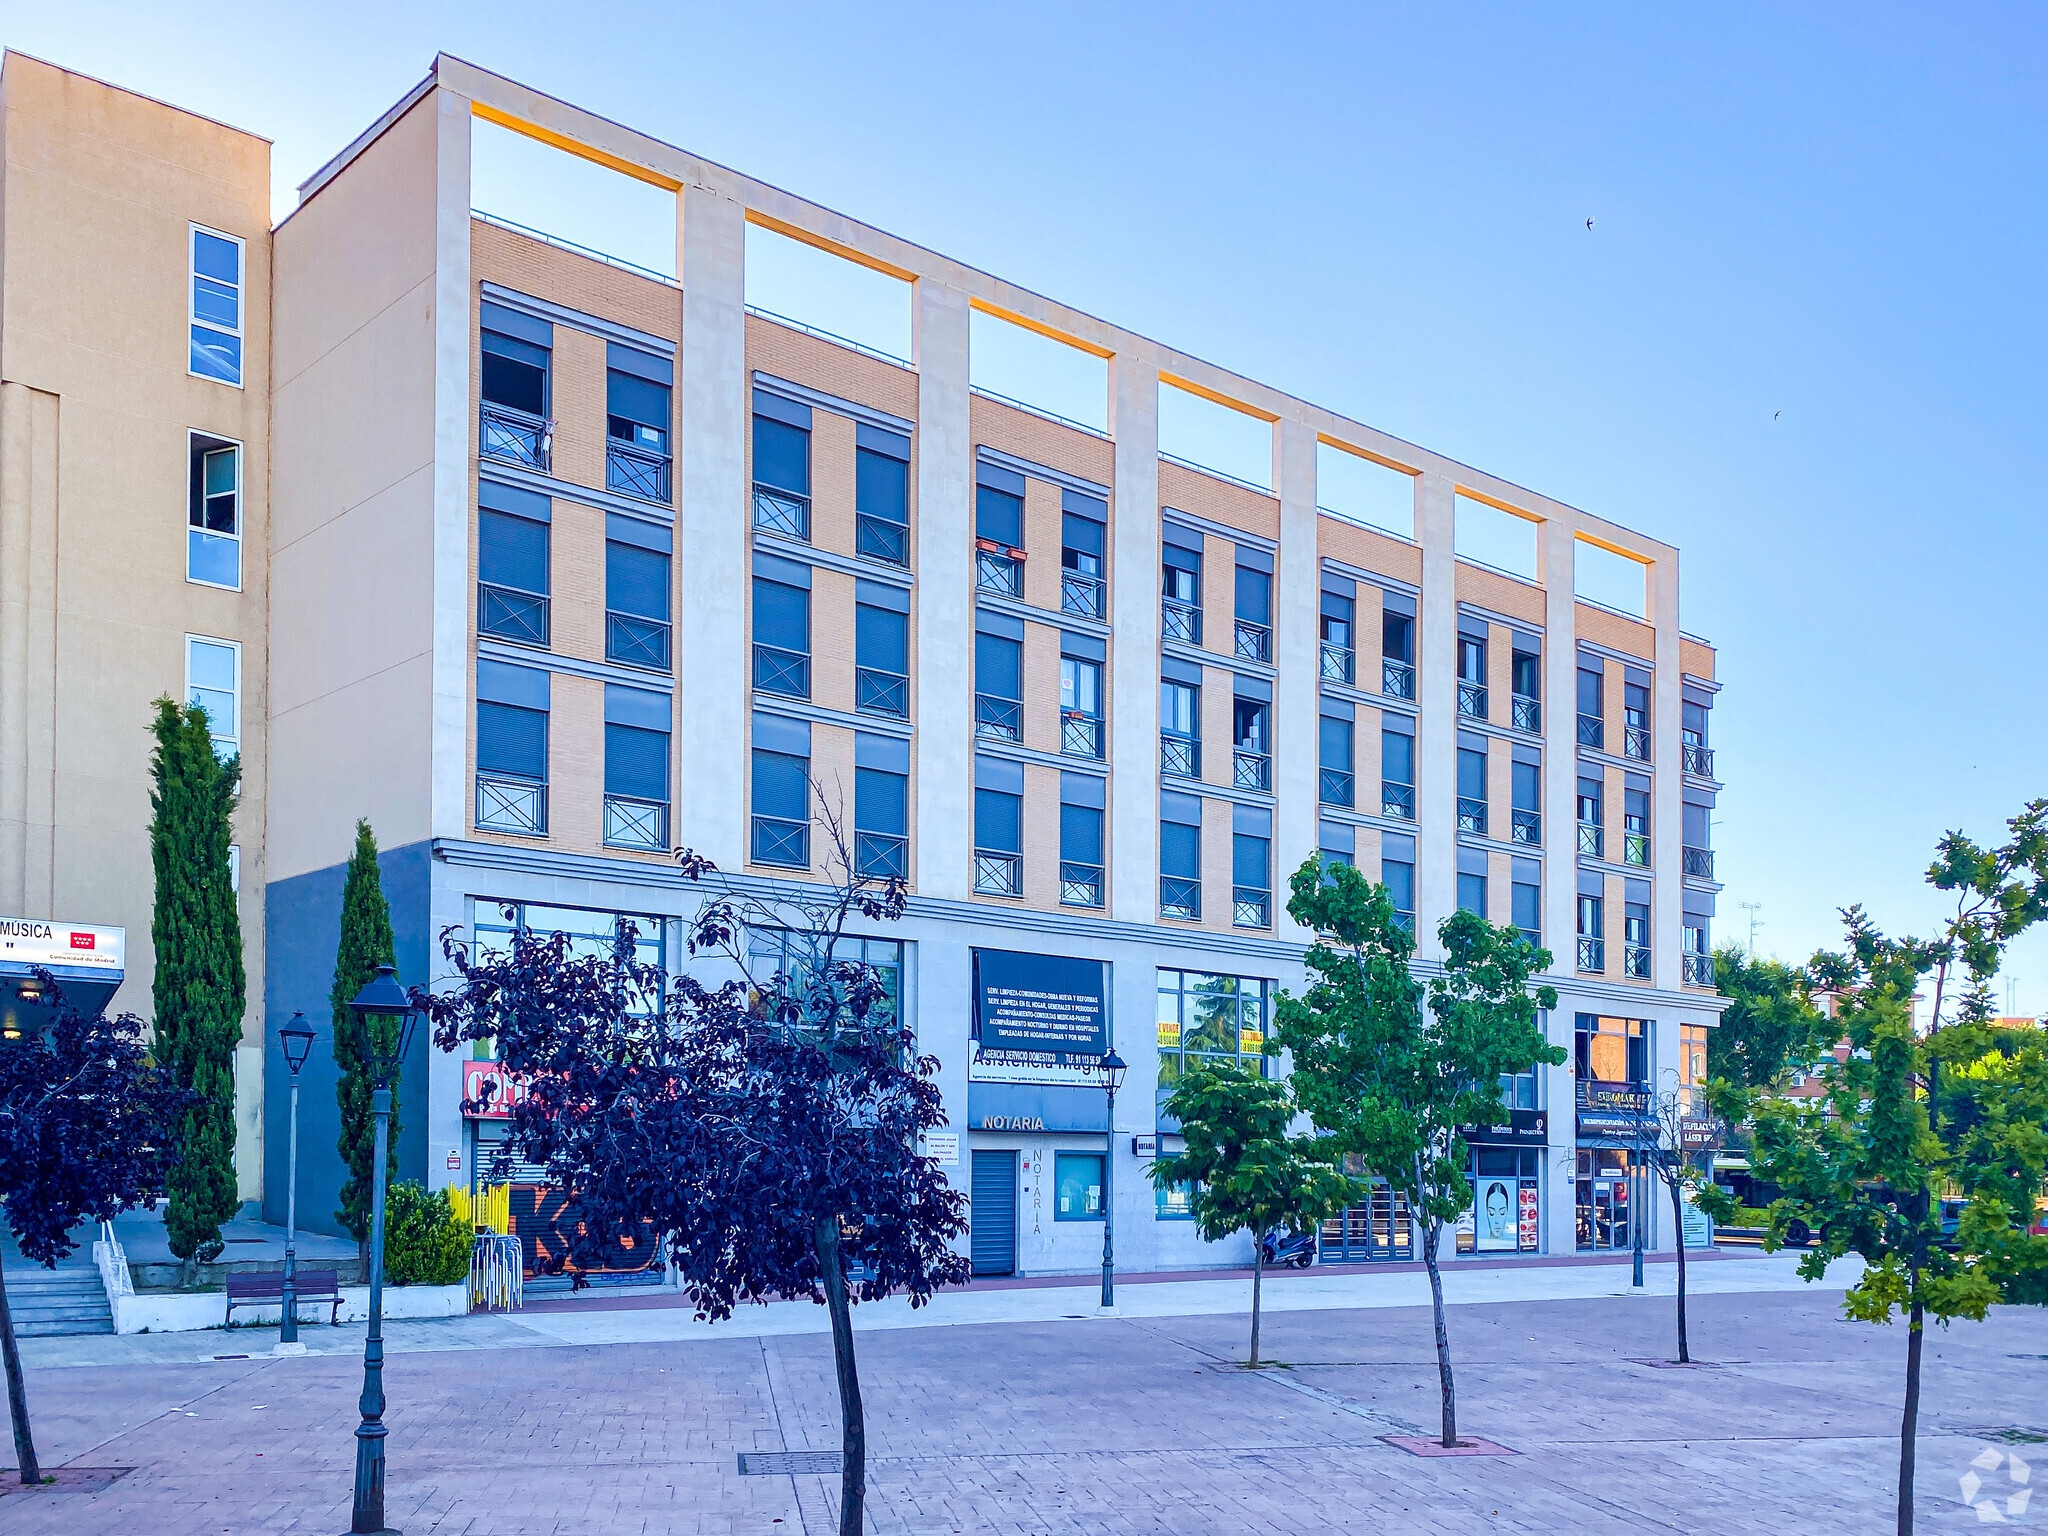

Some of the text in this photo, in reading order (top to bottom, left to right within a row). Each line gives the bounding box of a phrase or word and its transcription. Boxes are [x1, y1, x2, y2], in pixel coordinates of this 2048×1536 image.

[0, 919, 53, 940] MÚSICA
[49, 953, 84, 962] Comunidad
[1162, 1023, 1179, 1033] VENDE
[983, 1049, 1004, 1060] AGENCIA
[1006, 1050, 1028, 1061] SERVICIO
[1029, 1051, 1056, 1063] DOMESTICO
[982, 1114, 1044, 1130] NOTARIA
